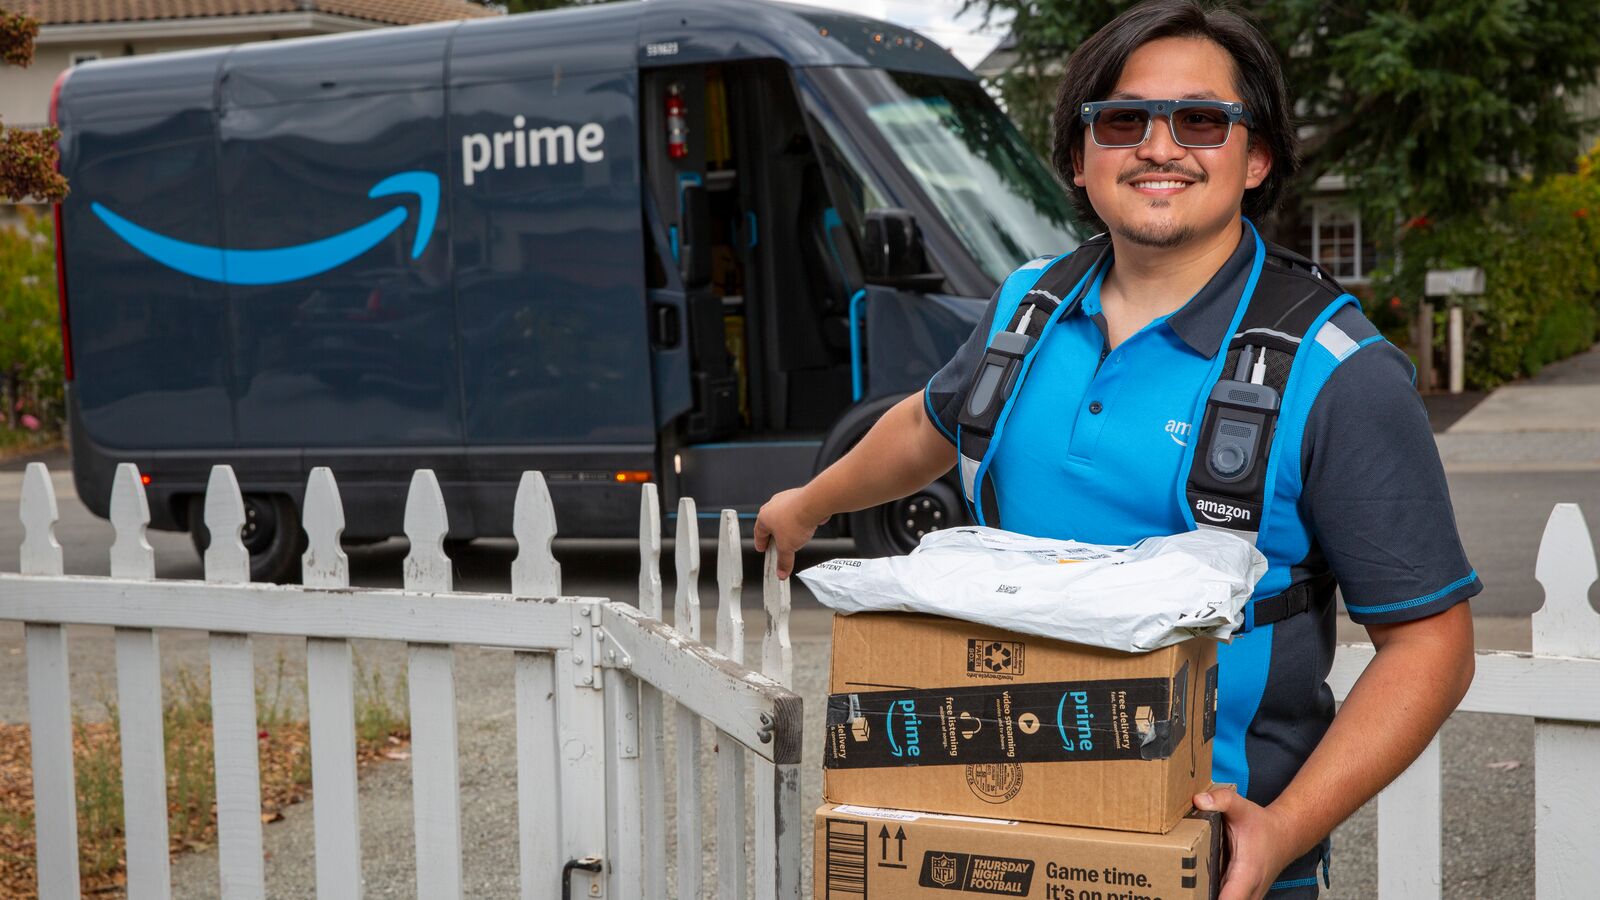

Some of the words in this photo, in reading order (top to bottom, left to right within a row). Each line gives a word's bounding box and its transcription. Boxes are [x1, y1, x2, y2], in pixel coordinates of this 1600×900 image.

[462, 114, 605, 186] prime
[1165, 419, 1192, 436] am
[1196, 499, 1251, 520] amazon
[946, 697, 954, 716] free
[1003, 690, 1012, 714] video
[1118, 690, 1126, 710] free
[898, 699, 922, 757] prime
[1070, 691, 1094, 751] prime
[1120, 713, 1130, 749] delivery
[948, 716, 959, 756] listening
[1005, 715, 1016, 757] streaming
[934, 868, 953, 882] NFL
[972, 869, 1006, 881] NIGHT
[974, 859, 1030, 873] THURSDAY
[1046, 861, 1099, 882] Game
[1103, 867, 1152, 888] time.
[970, 878, 1022, 893] FOOTBALL
[1079, 889, 1102, 900] on
